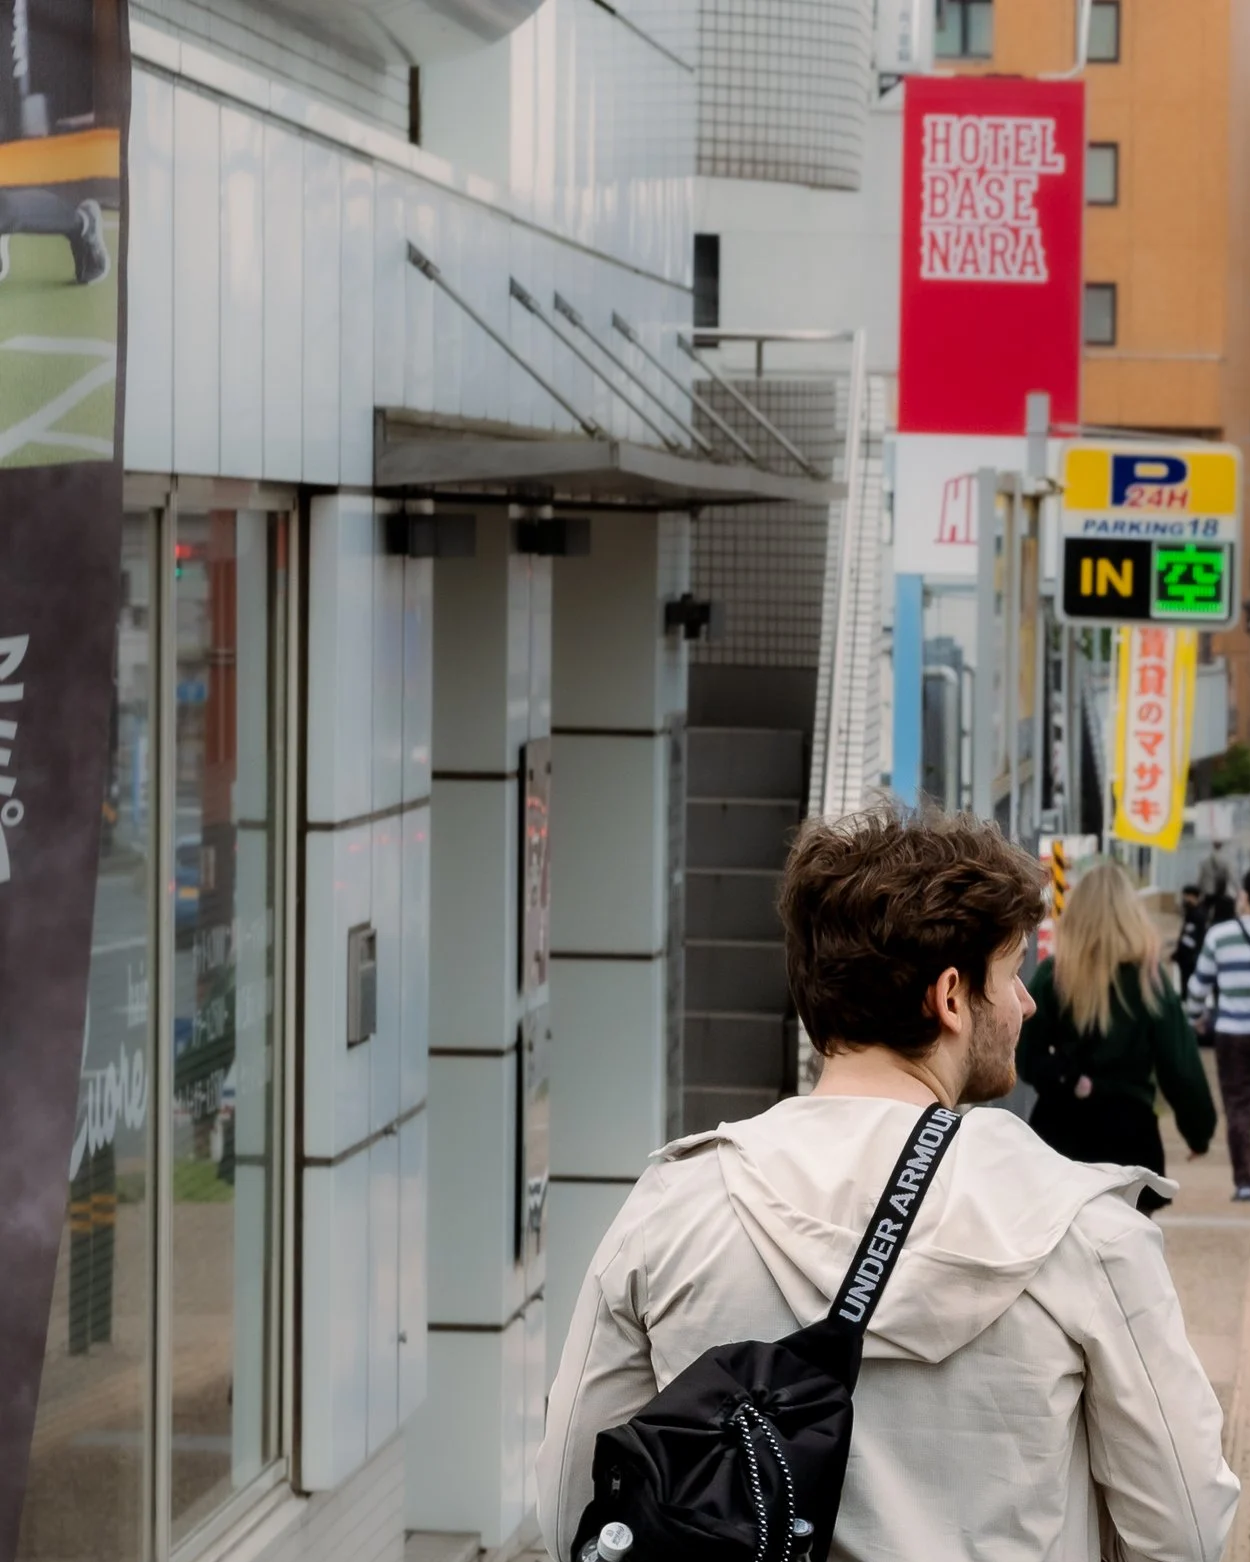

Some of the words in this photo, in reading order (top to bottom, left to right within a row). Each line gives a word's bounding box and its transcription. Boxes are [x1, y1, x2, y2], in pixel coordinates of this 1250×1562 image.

[926, 117, 1062, 170] HOTEL
[926, 173, 1035, 222] BASE
[926, 229, 1043, 278] NARA
[1111, 454, 1188, 507] P
[1124, 486, 1189, 509] 24H
[1080, 557, 1134, 597] IN
[1156, 543, 1224, 613] 空
[838, 1217, 903, 1323] UNDER
